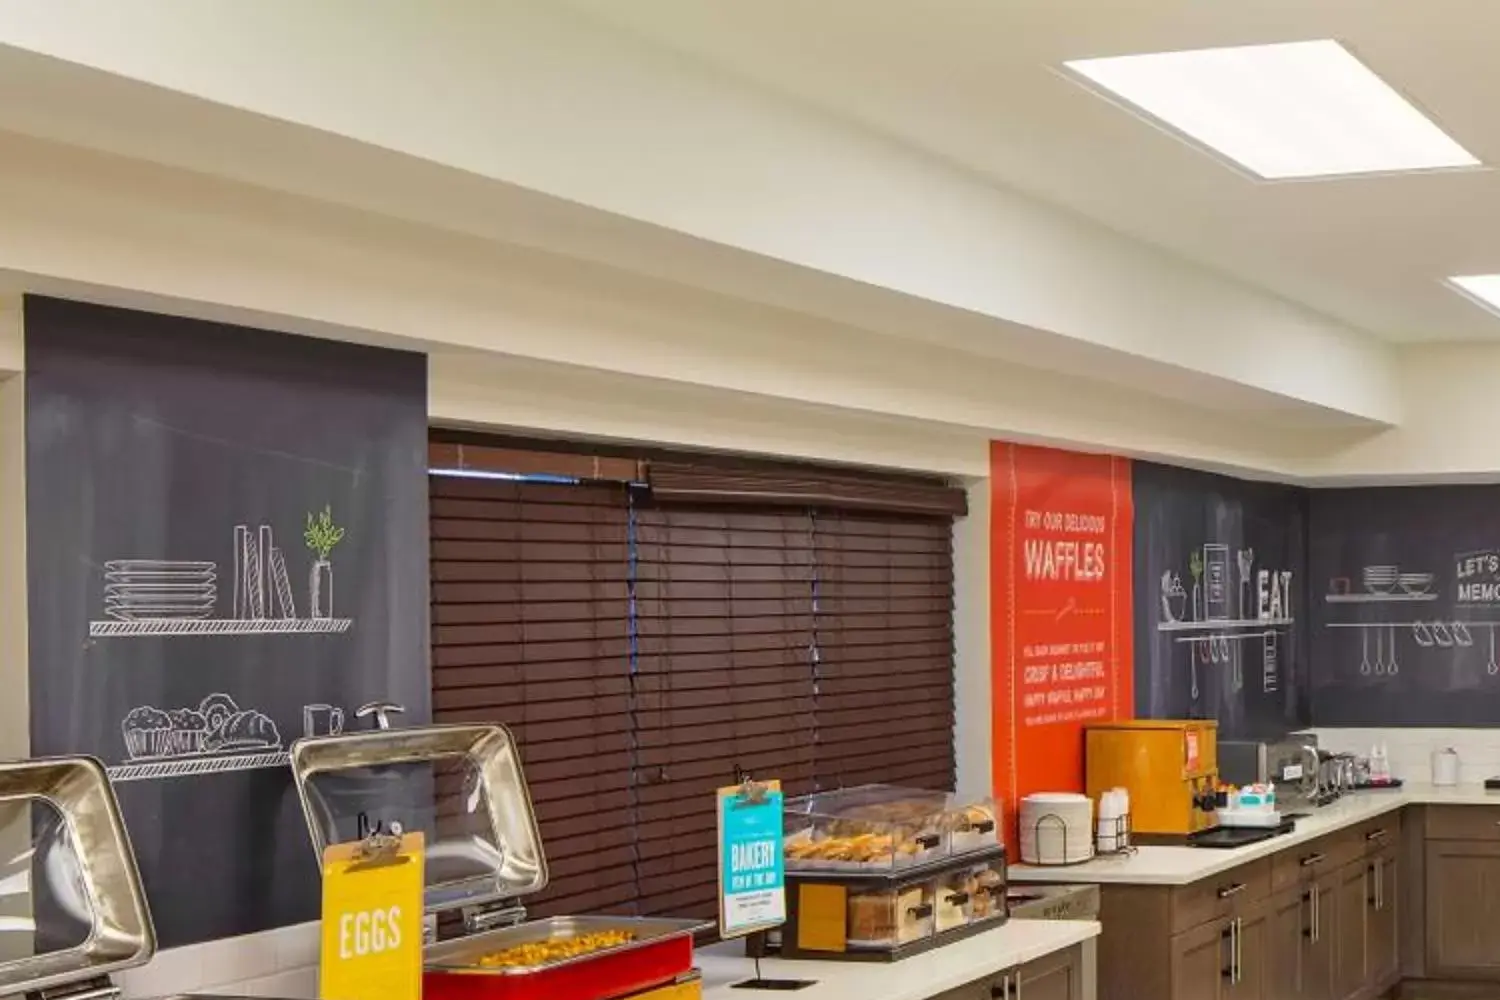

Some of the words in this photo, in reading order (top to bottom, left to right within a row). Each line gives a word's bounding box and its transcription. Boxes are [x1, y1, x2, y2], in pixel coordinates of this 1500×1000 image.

[1043, 511, 1063, 532] OUR
[1024, 539, 1105, 581] WAFFLES
[1456, 554, 1499, 578] LET'S
[1258, 569, 1292, 624] EAT
[731, 840, 776, 872] BAKERY
[339, 905, 402, 960] EGGS
